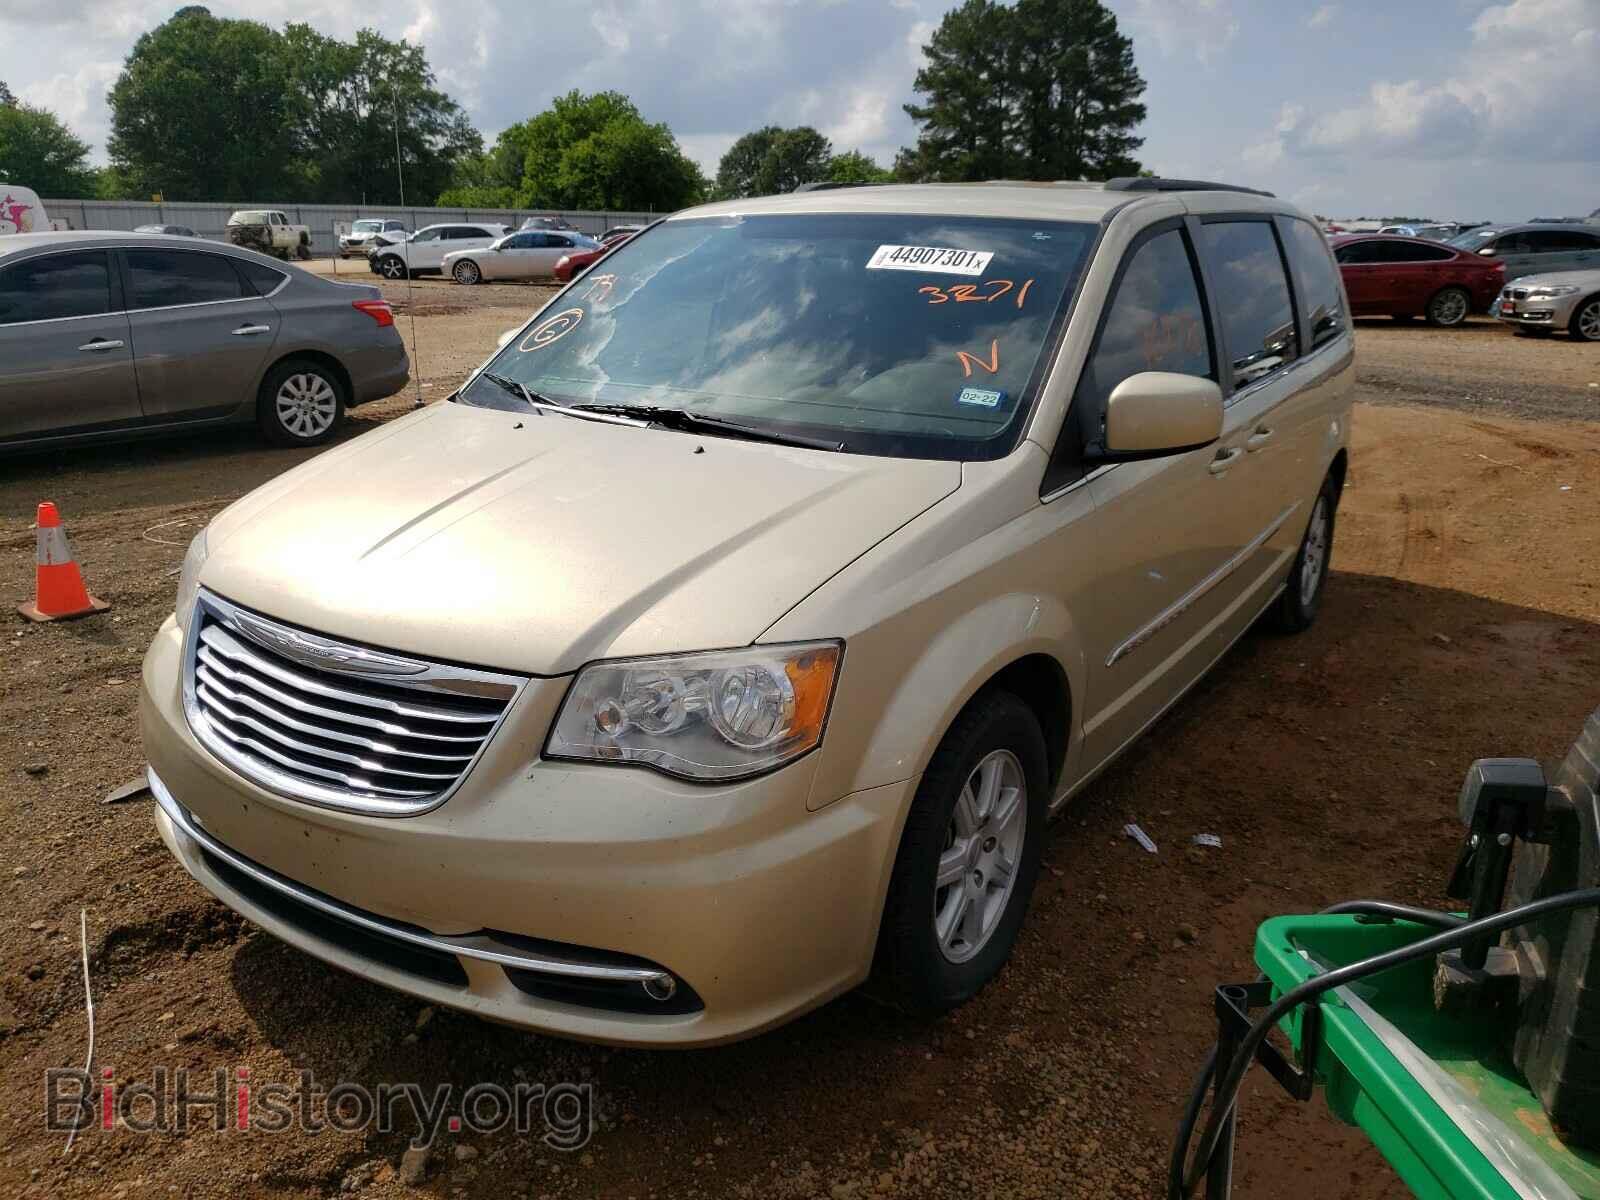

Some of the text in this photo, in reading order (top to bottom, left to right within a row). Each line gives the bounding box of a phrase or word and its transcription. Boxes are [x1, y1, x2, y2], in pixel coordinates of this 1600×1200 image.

[889, 247, 977, 268] 44907301
[956, 337, 999, 379] N
[962, 391, 998, 405] 02-22
